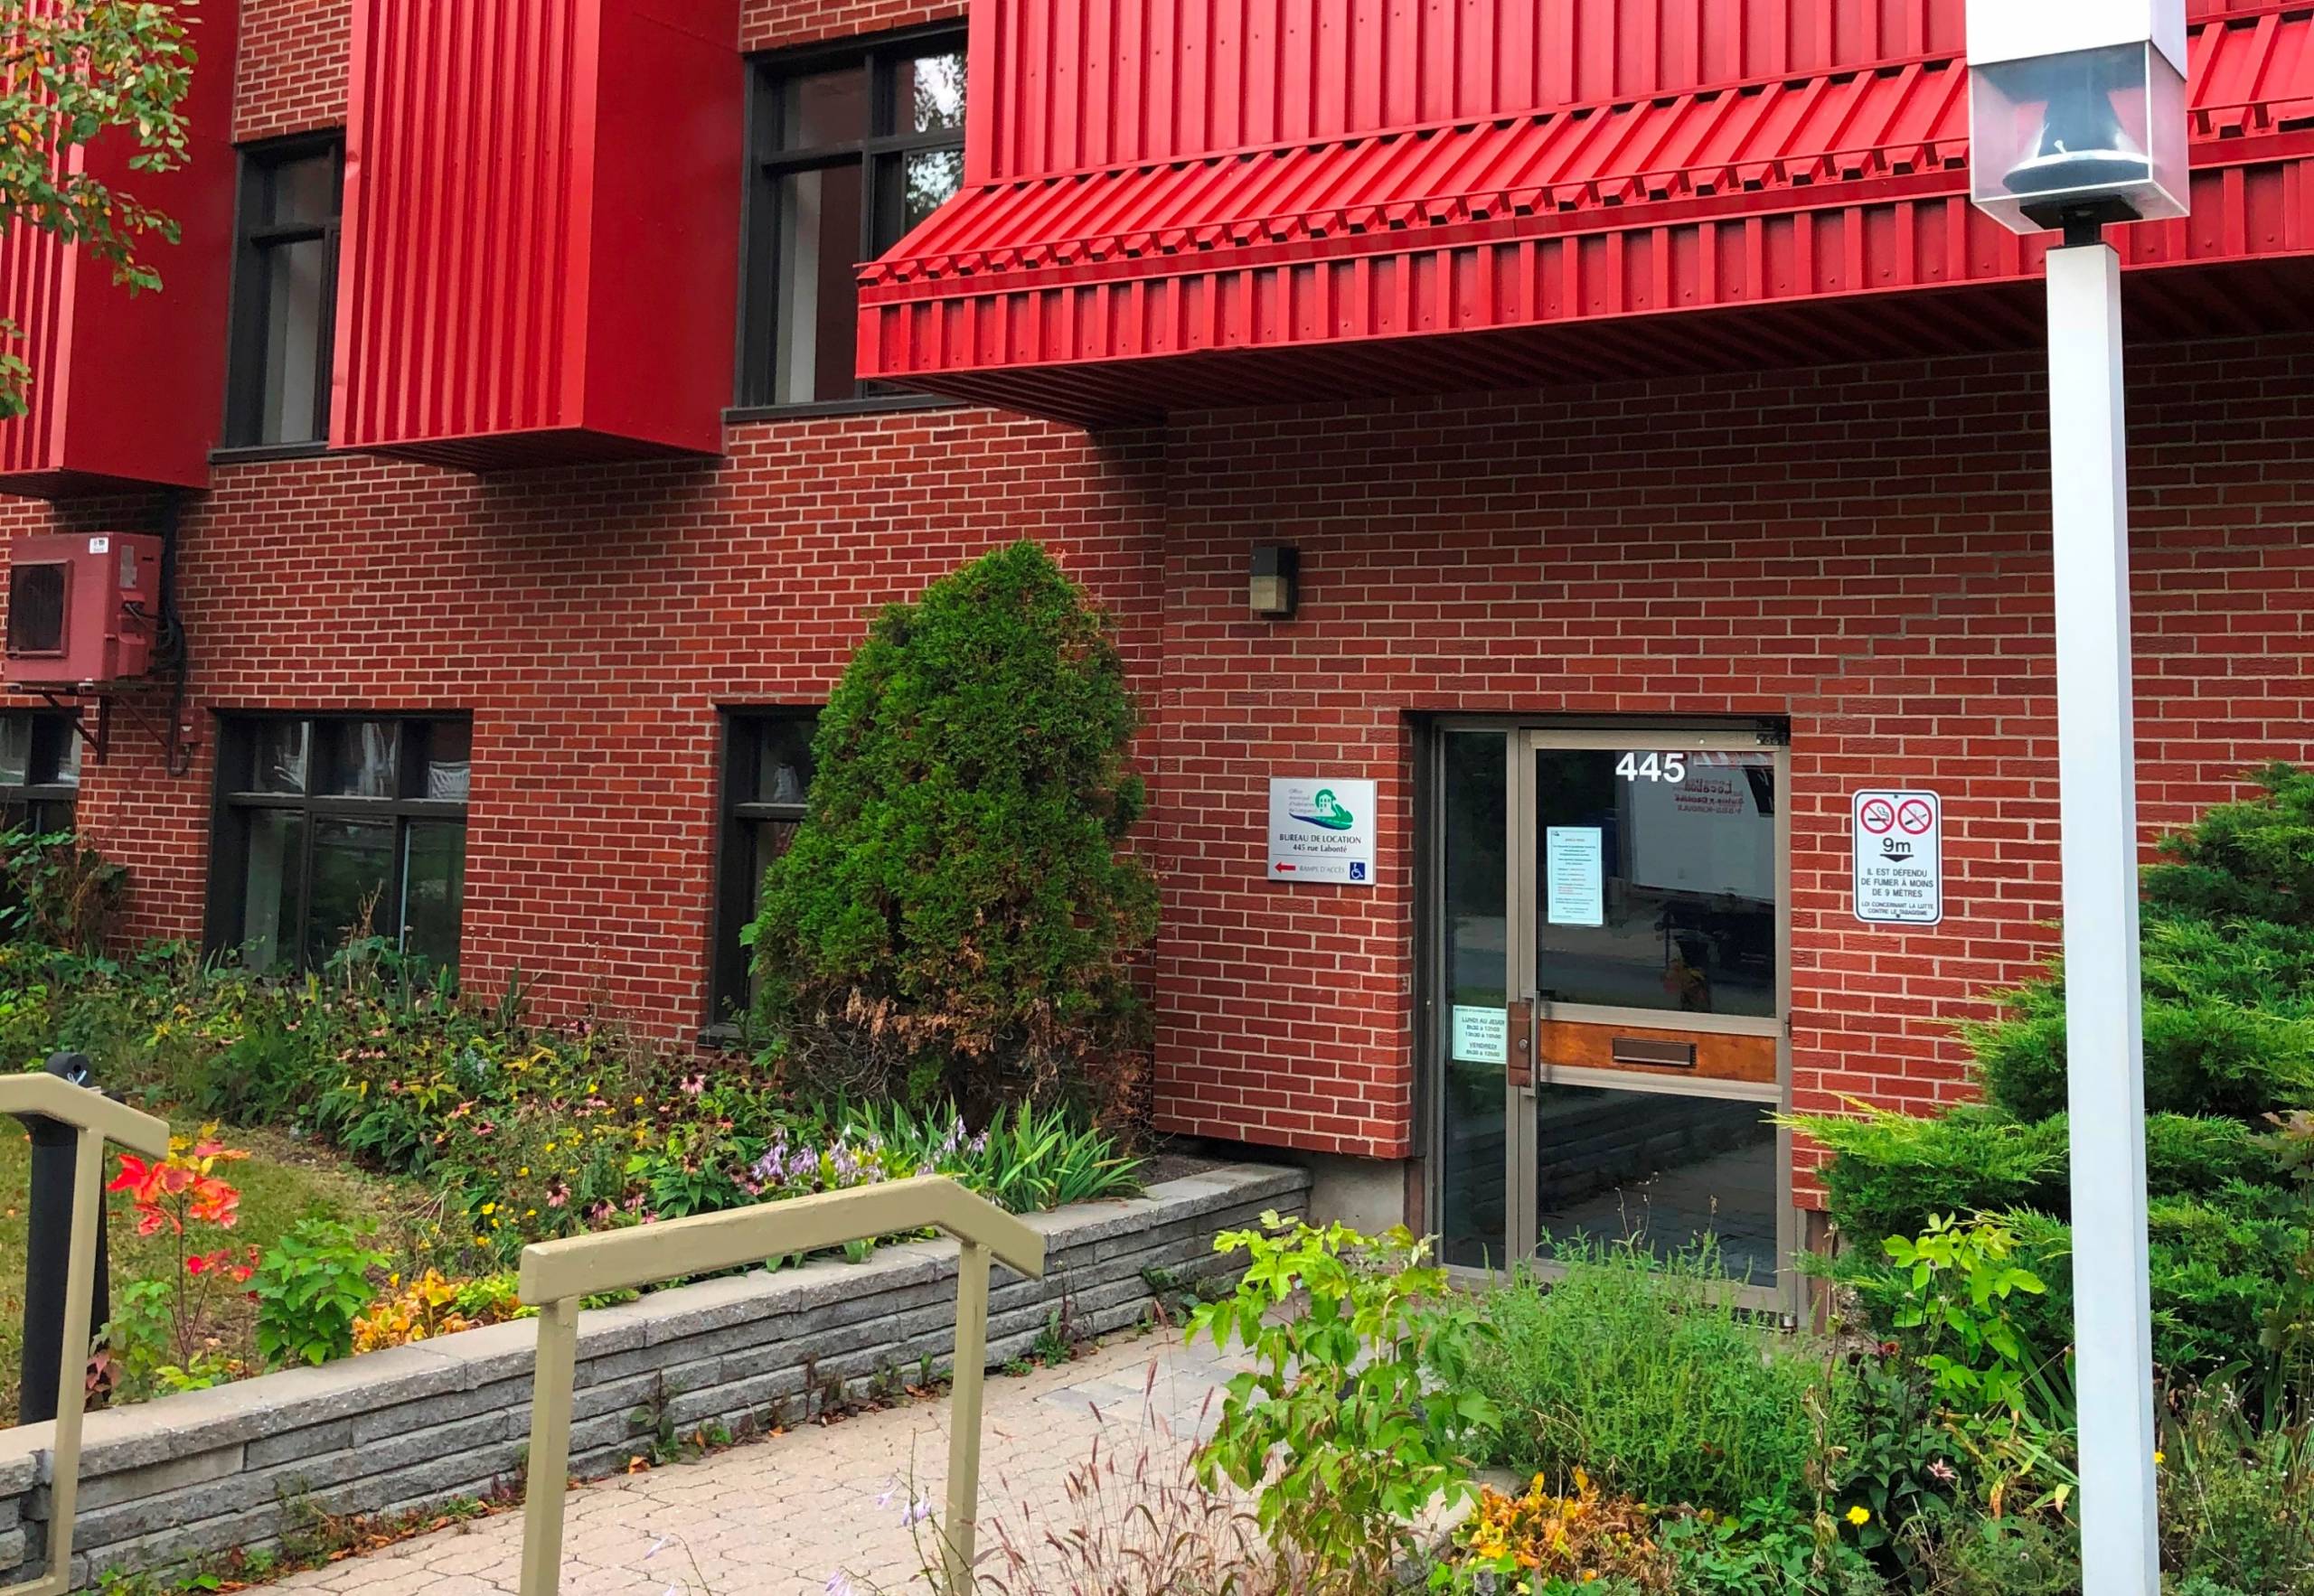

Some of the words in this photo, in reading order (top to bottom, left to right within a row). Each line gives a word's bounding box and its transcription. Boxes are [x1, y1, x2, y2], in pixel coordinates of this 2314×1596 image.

[1615, 752, 1686, 783] 445
[1279, 833, 1309, 841] BUREAU
[1322, 835, 1361, 843] LOCATION
[1321, 845, 1347, 853] Labonté
[1882, 837, 1911, 852] 9m
[1876, 868, 1889, 876] EST
[1893, 868, 1927, 877] DÉFENDU
[1861, 878, 1871, 886] DE
[1909, 879, 1934, 887] MOINS
[1885, 888, 1890, 897] 9
